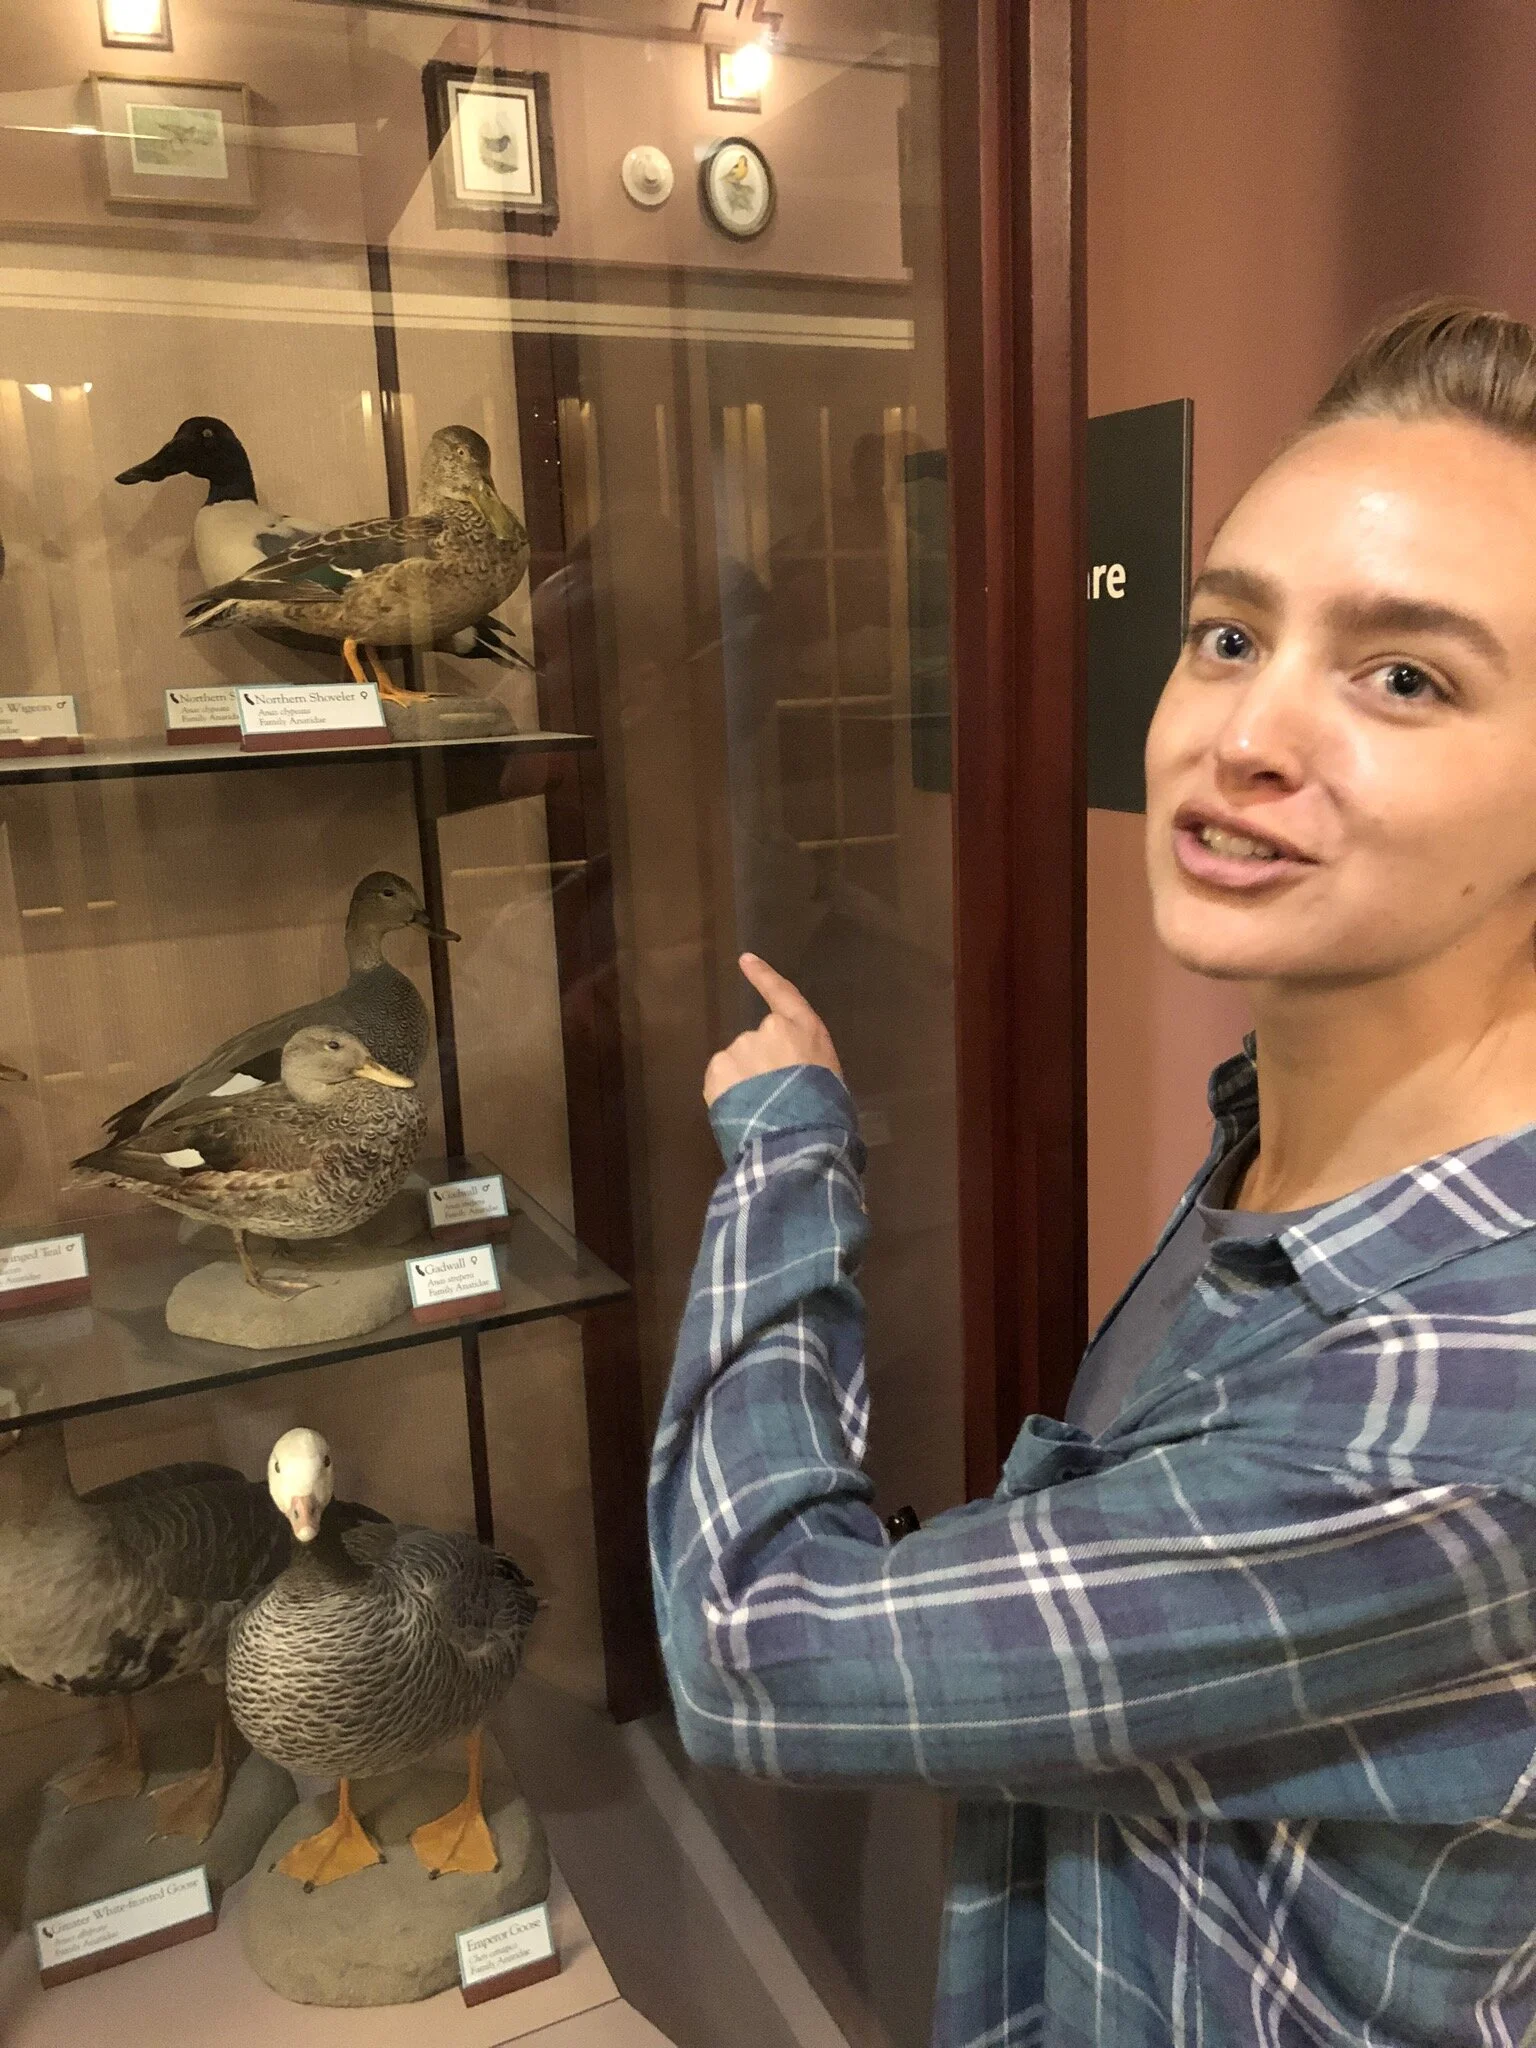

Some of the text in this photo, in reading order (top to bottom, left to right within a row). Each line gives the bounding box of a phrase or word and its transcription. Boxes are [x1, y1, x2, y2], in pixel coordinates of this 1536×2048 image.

[180, 692, 227, 703] Northern
[255, 691, 356, 705] Northern Shoveler
[260, 718, 286, 726] Family
[441, 1186, 478, 1199] Gadwall
[41, 1244, 61, 1257] Teal
[425, 1258, 466, 1275] Gadwall
[428, 1286, 454, 1298] Family
[166, 1879, 199, 1896] Goose
[467, 1931, 507, 1952] Emperor
[509, 1919, 541, 1936] Goose
